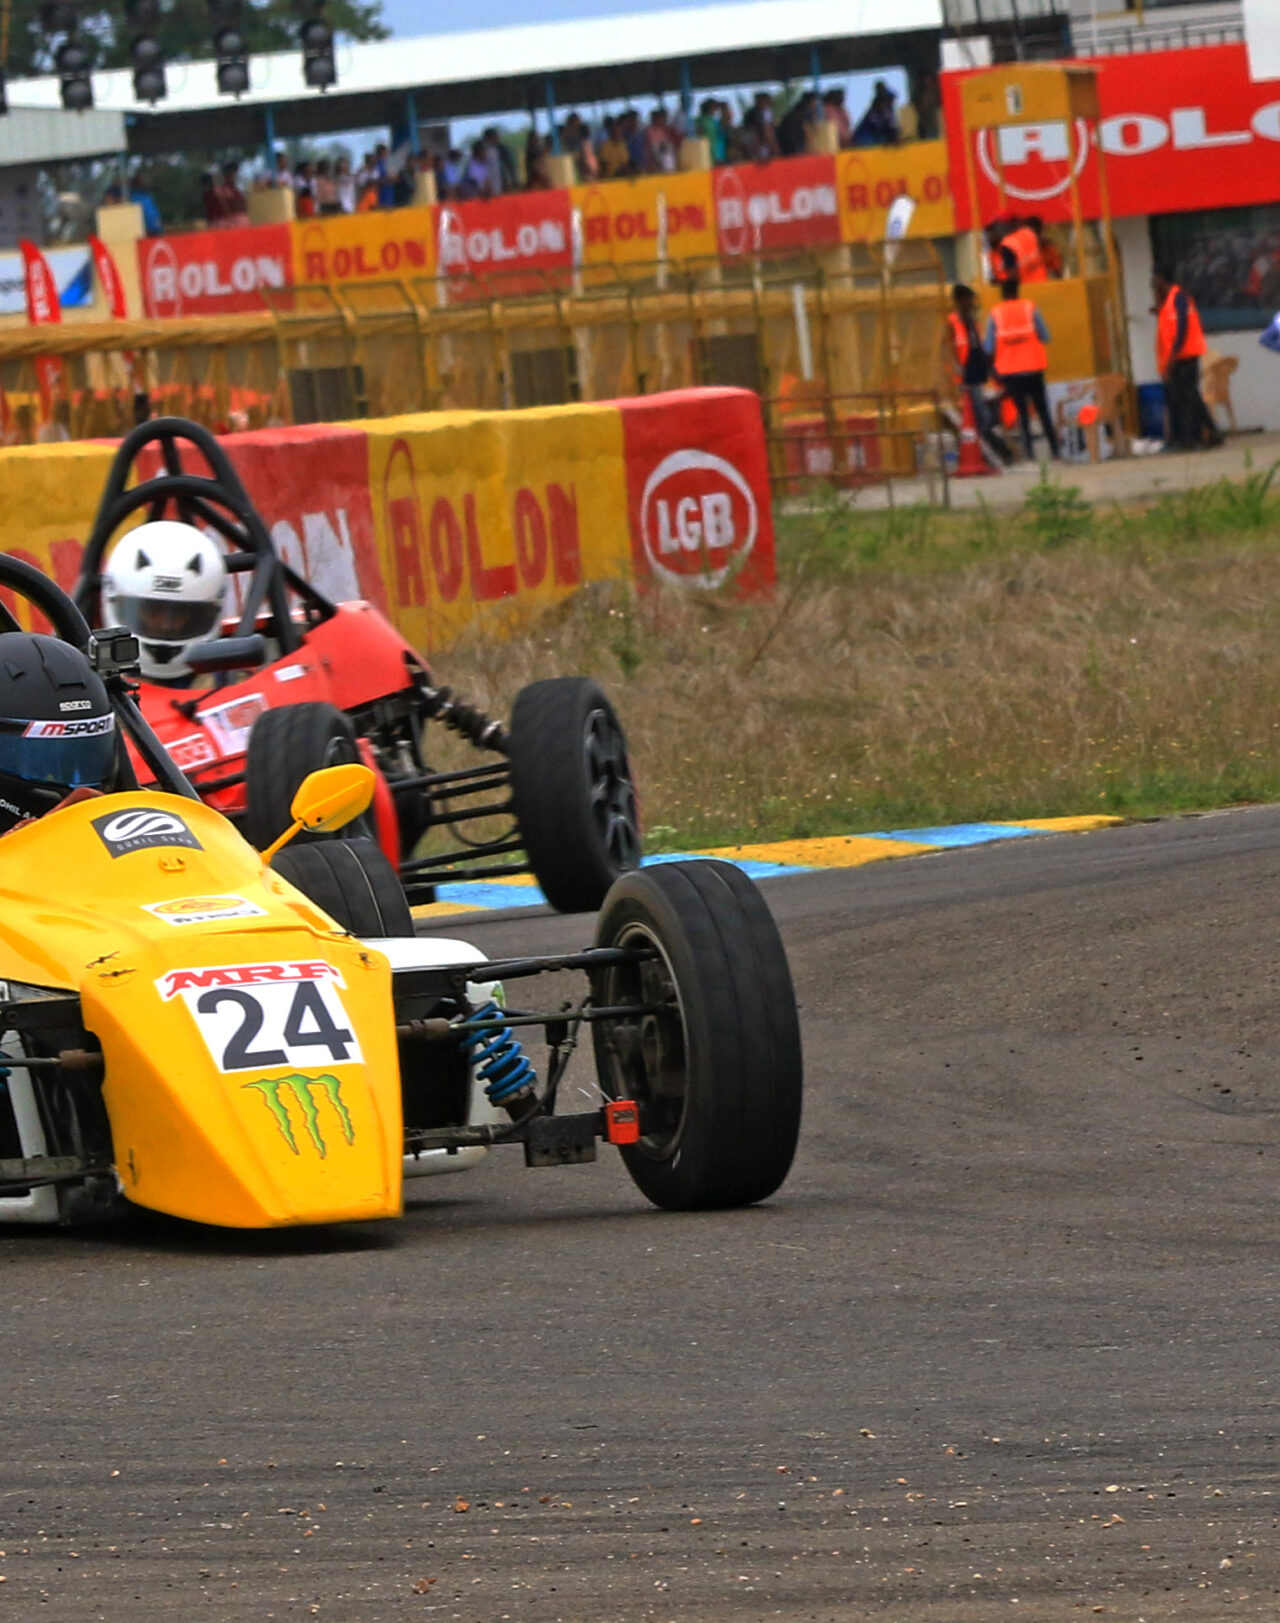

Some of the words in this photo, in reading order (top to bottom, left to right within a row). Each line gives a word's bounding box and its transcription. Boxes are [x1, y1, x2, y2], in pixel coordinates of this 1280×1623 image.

[440, 220, 565, 266] ROLON
[586, 205, 706, 243] ROLON
[150, 257, 285, 301] ROLON
[304, 240, 427, 281] ROLON
[386, 482, 583, 607] ROLON
[656, 492, 736, 554] LGB
[165, 962, 340, 998] MRF
[197, 980, 355, 1070] 24
